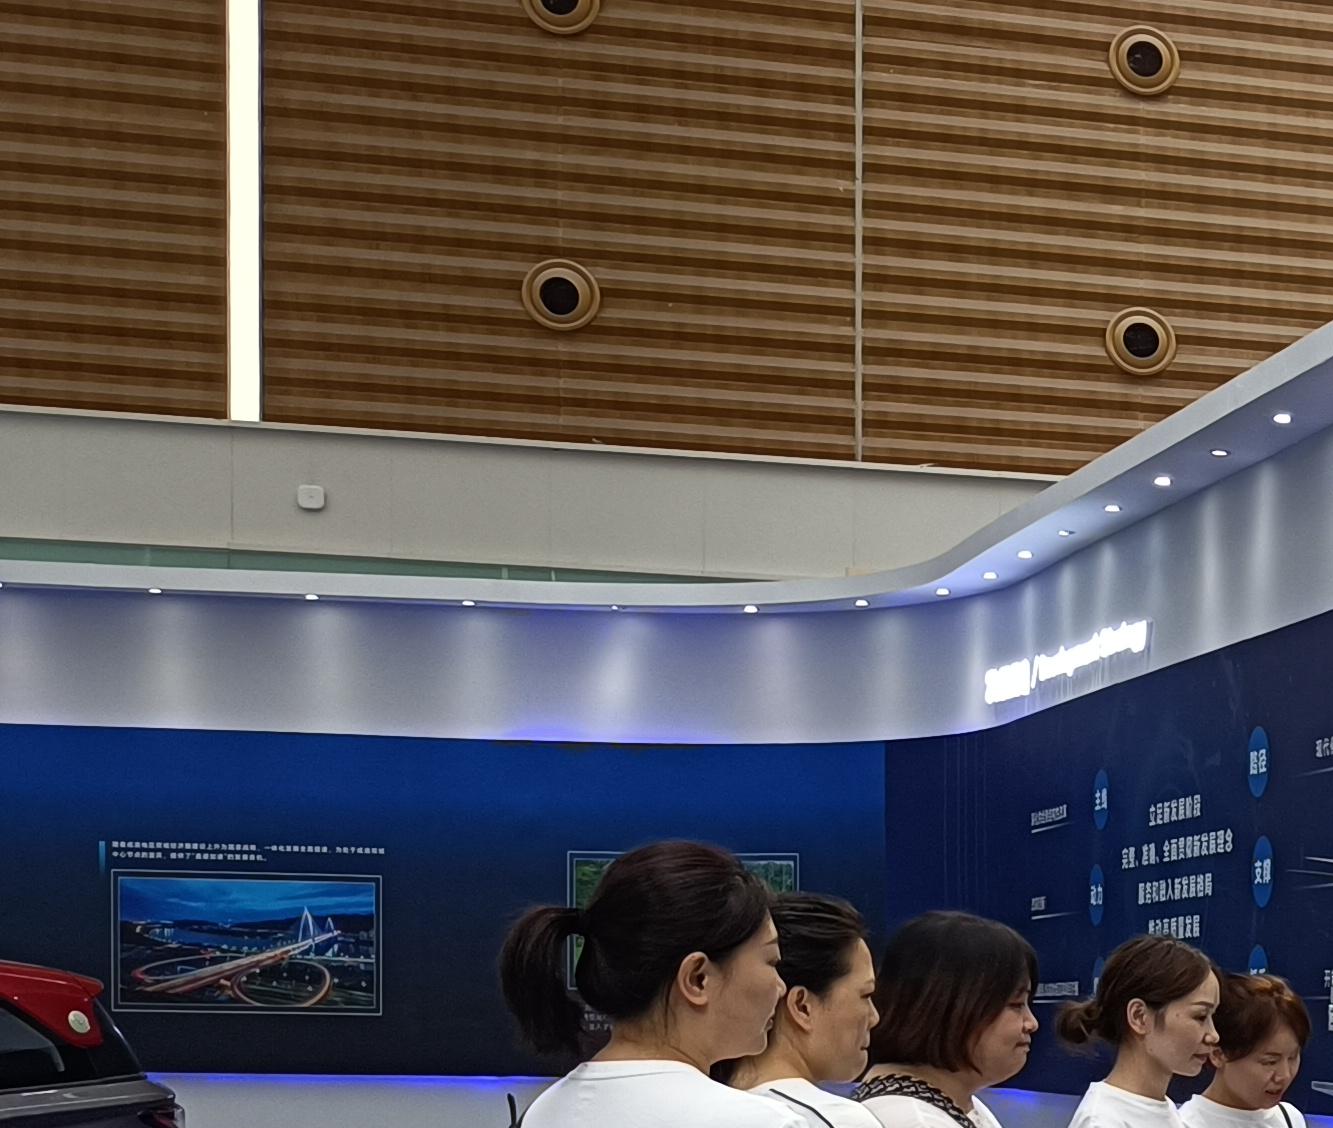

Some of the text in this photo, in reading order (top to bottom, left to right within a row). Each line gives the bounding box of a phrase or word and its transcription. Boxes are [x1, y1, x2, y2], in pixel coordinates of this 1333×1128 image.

[1149, 794, 1201, 827] 立足新发展阶段
[1121, 828, 1233, 870] 完整、准确、全面贯彻新发展理念
[1138, 873, 1213, 906] 服务和融入新发展格局
